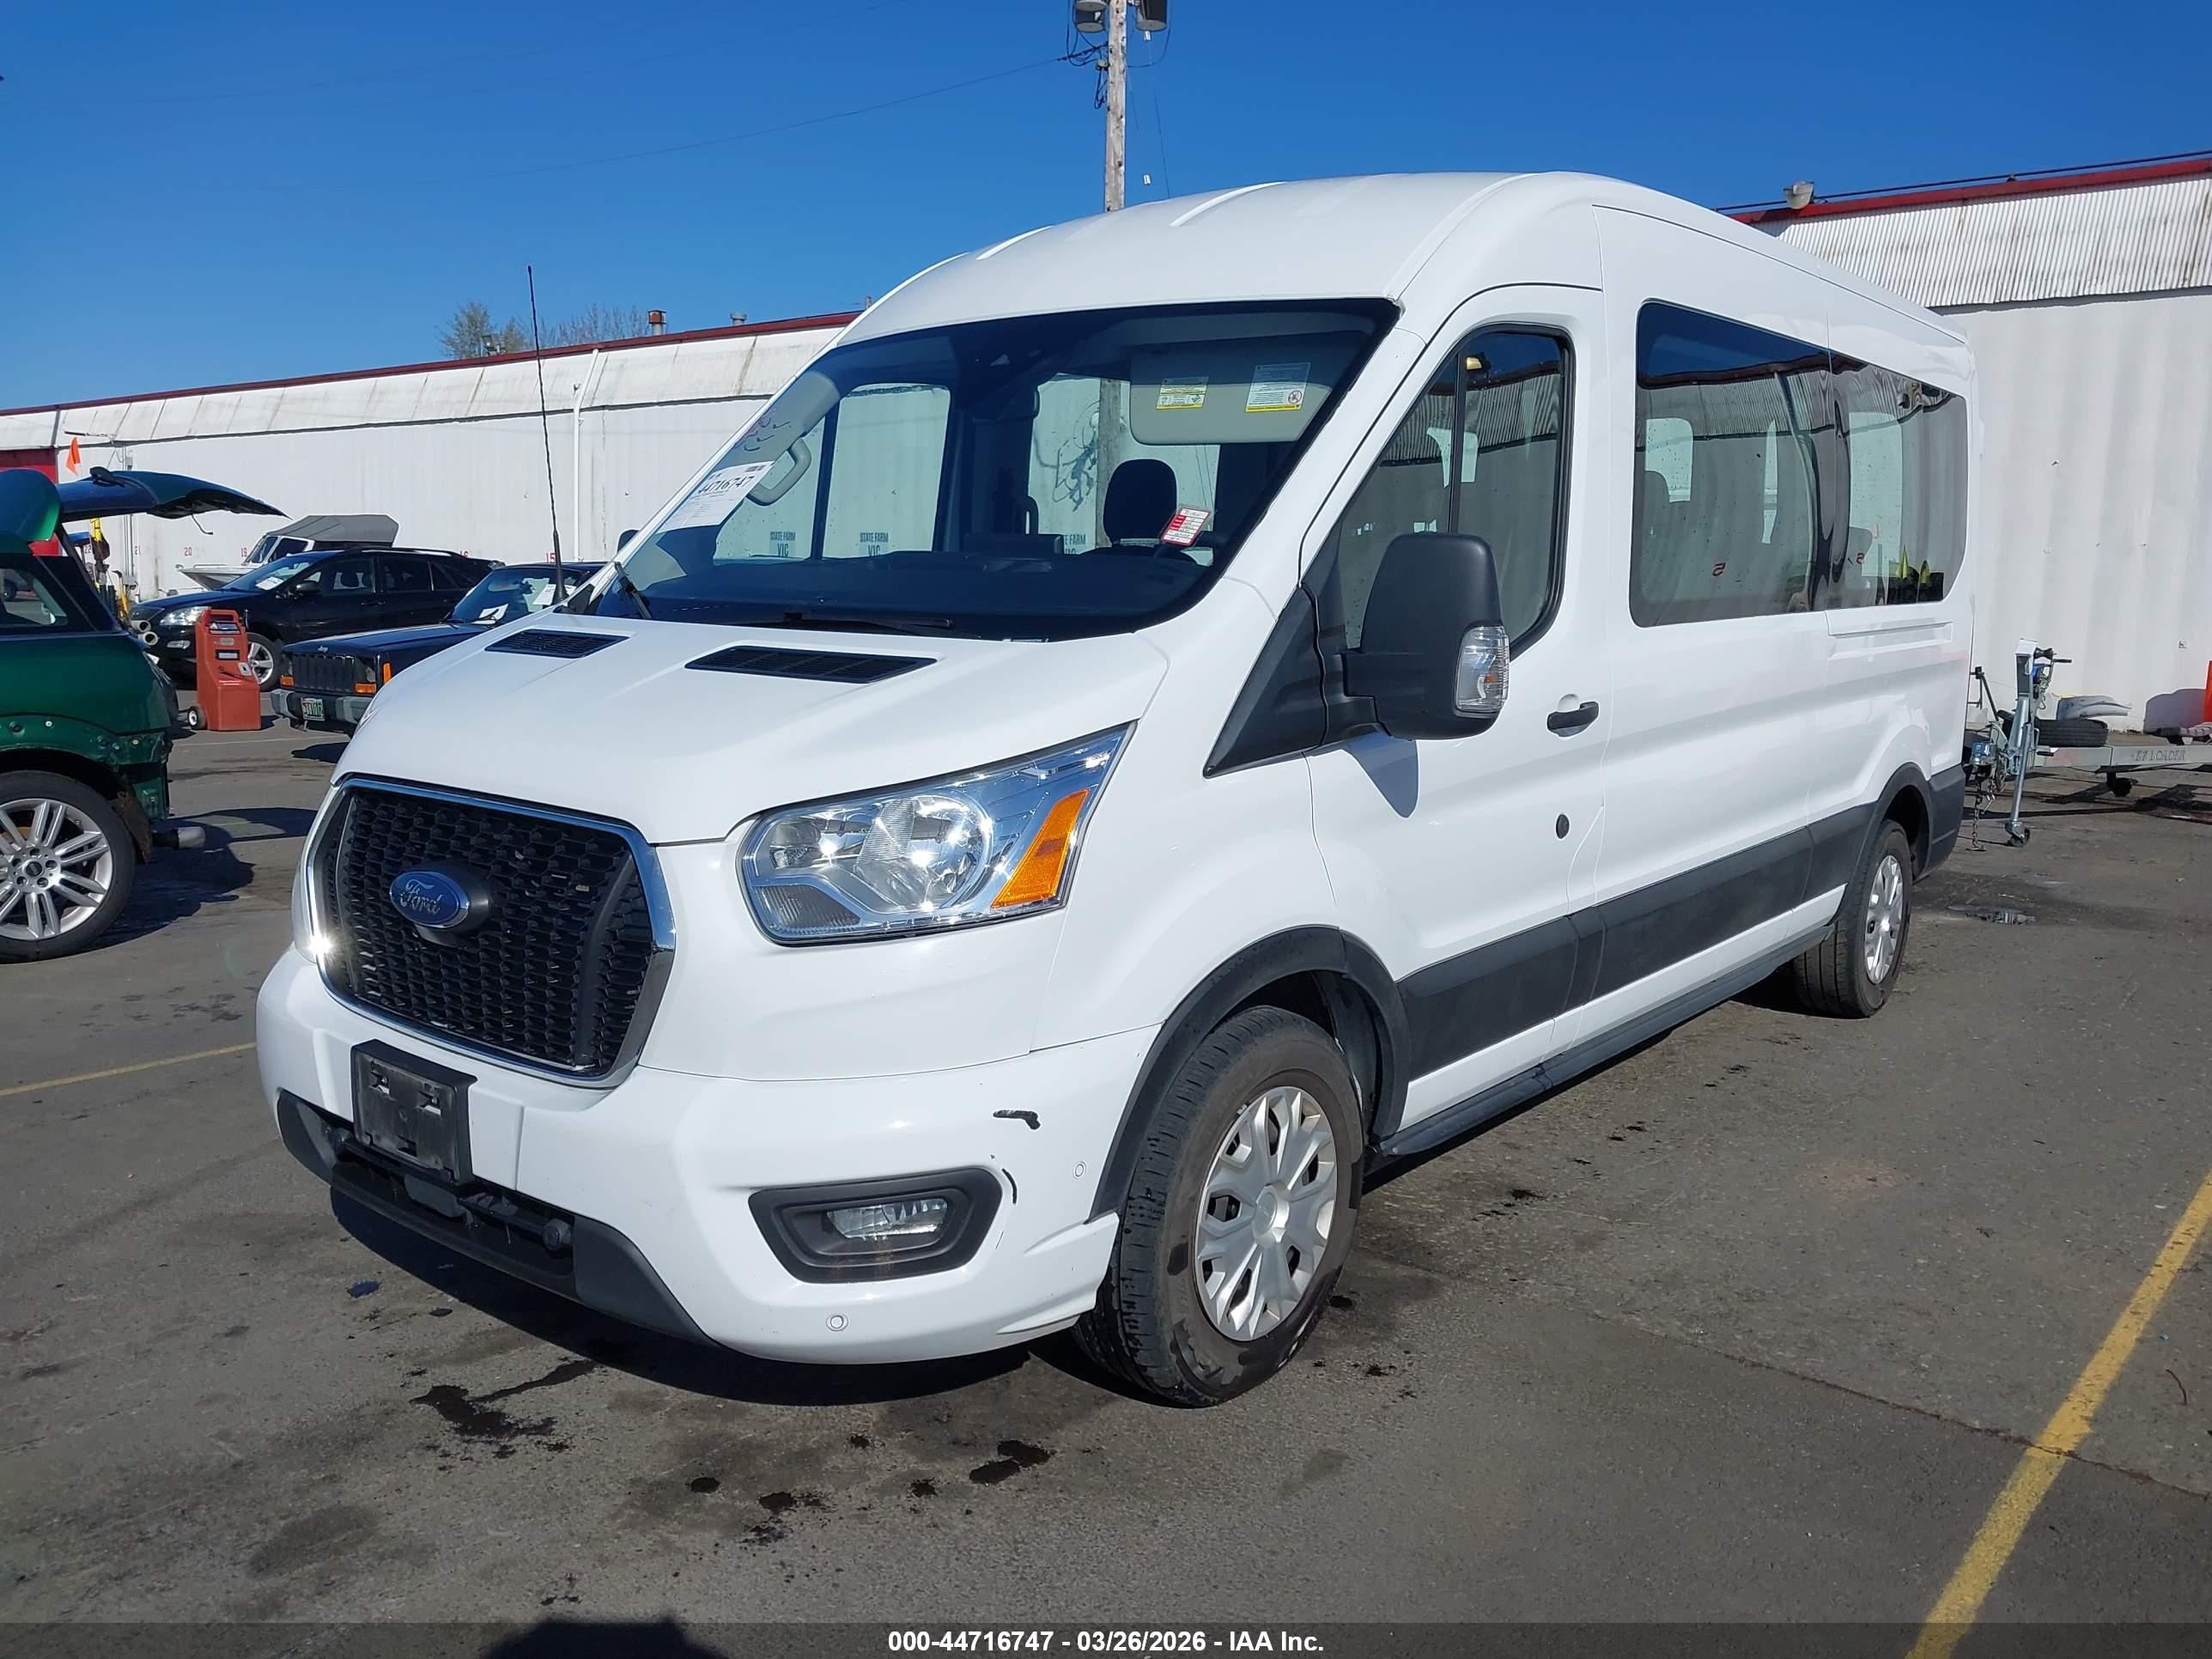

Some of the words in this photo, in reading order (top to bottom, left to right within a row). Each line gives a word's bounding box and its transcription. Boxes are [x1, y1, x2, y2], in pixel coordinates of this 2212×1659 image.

[770, 531, 783, 541] STATE
[783, 531, 796, 541] FARM
[860, 532, 874, 543] STATE
[874, 532, 889, 543] FARM
[1069, 534, 1086, 544] FARM
[185, 547, 192, 556] 20
[240, 547, 247, 557] 19
[777, 544, 789, 557] VIC
[399, 878, 443, 915] Ford
